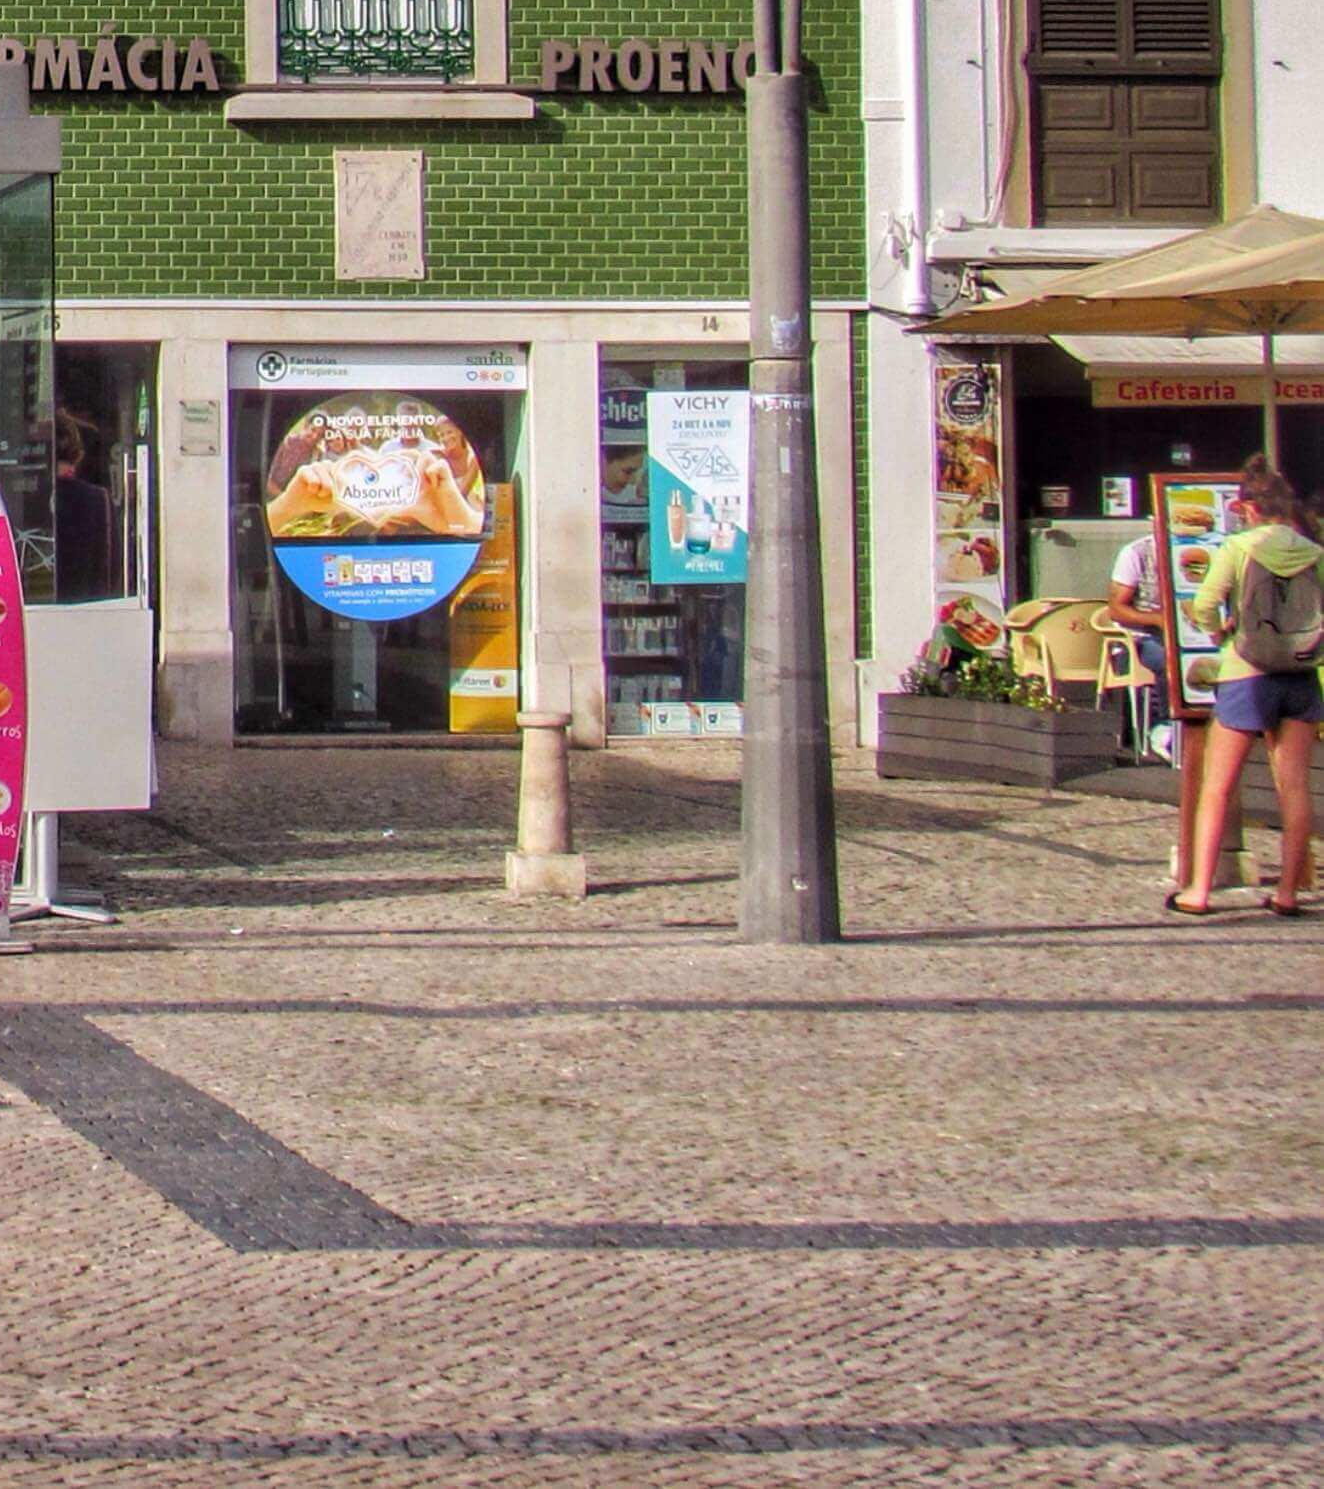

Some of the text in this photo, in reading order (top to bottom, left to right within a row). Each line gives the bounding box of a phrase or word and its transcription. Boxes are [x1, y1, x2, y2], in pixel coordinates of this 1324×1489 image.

[1117, 379, 1236, 401] Cafetaria
[673, 396, 729, 410] VICHY
[313, 413, 436, 427] O NOVO ELEMENTO
[324, 428, 342, 440] DA
[344, 427, 372, 440] SUA
[341, 484, 402, 500] Absorvit
